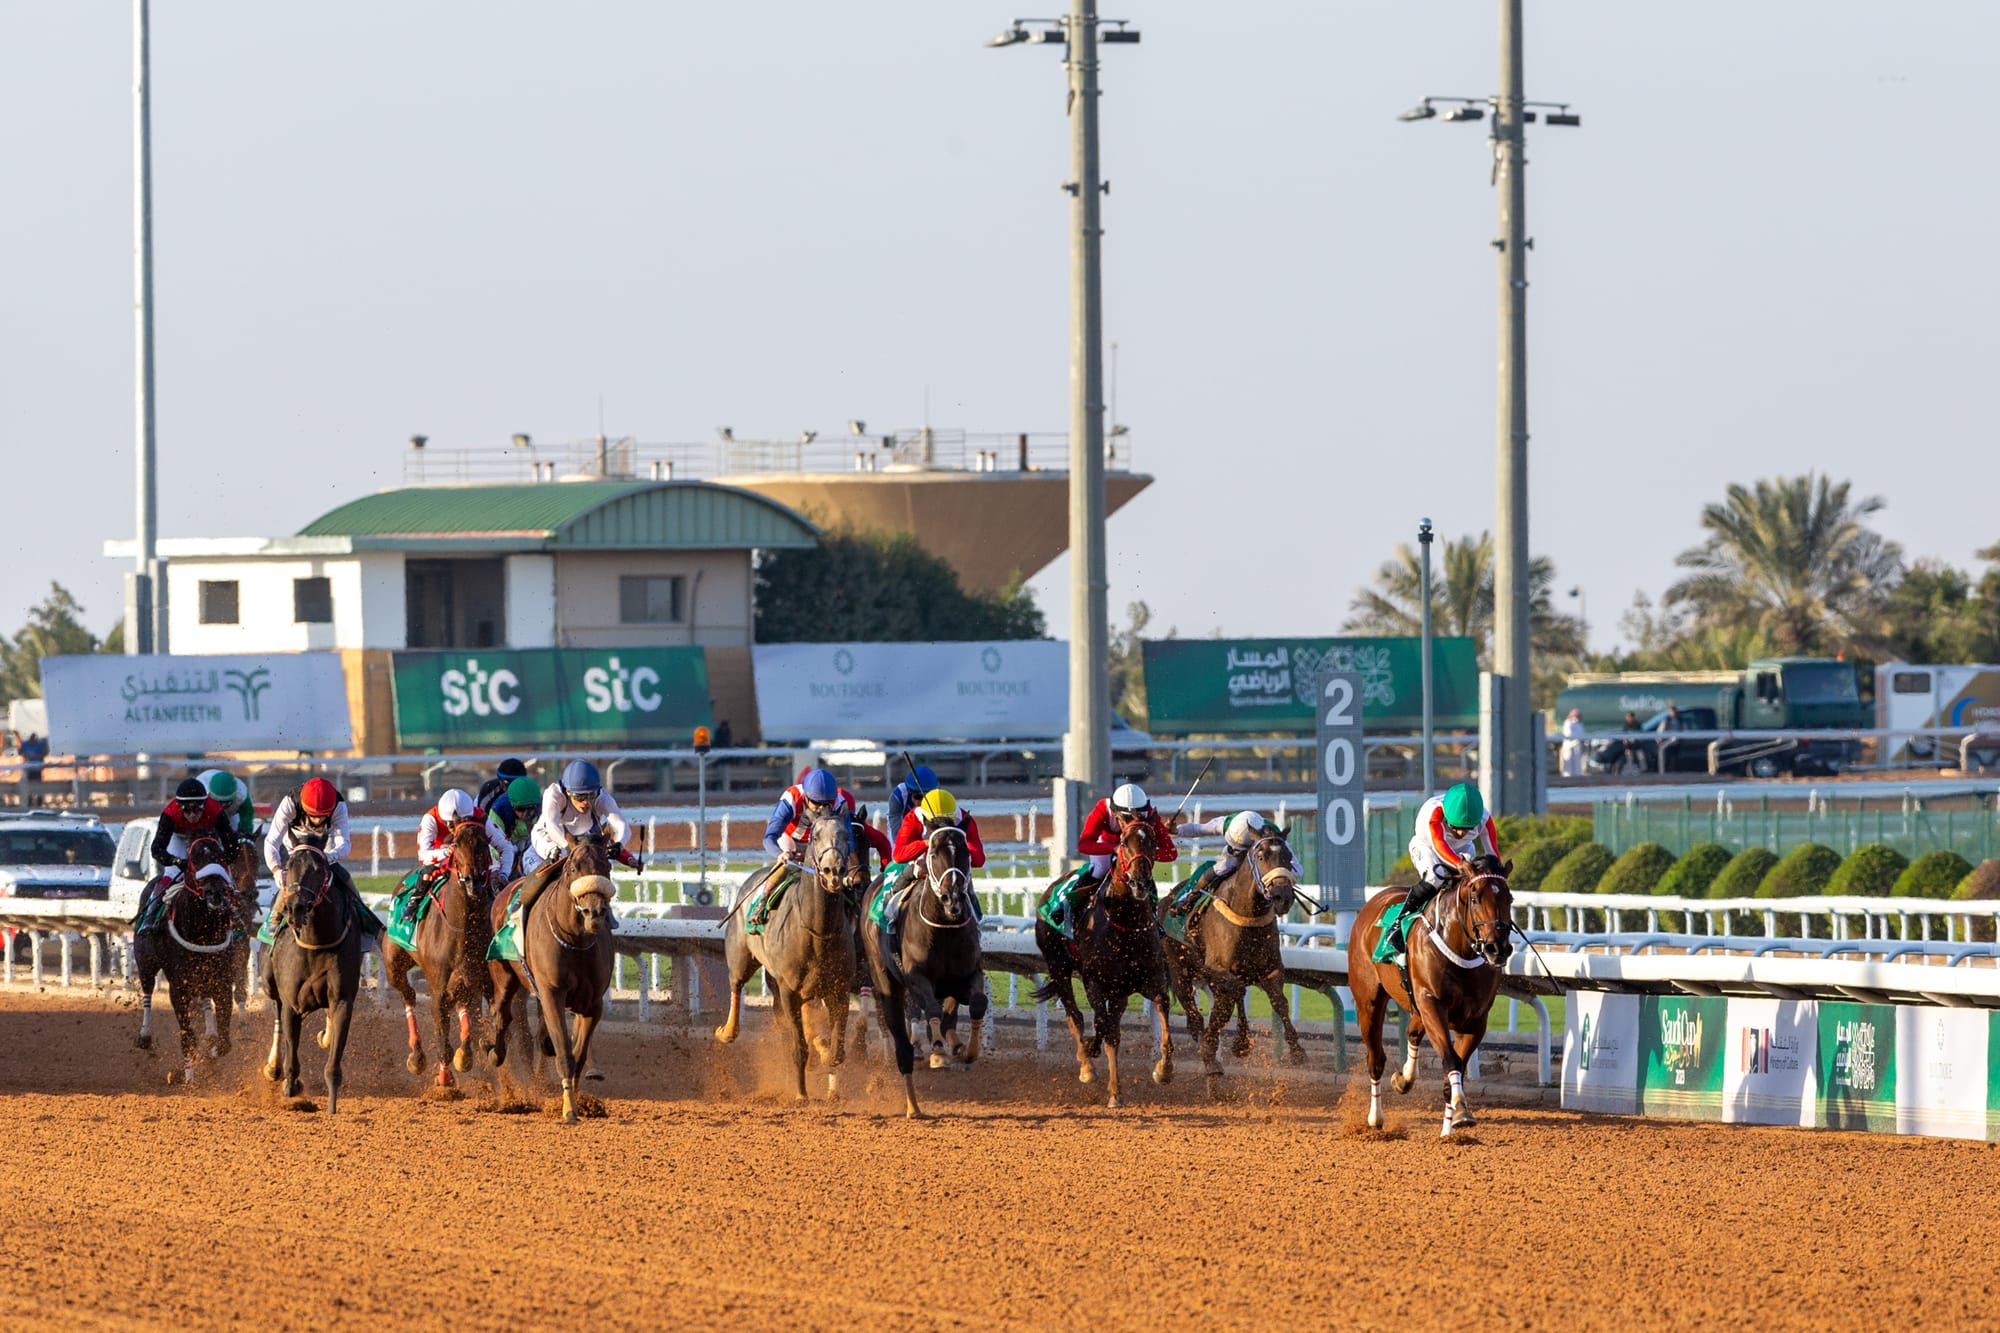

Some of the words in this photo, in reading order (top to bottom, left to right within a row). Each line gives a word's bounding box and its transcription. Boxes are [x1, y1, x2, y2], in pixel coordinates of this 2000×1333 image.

[1226, 646, 1289, 671] المسار
[120, 668, 220, 704] التنفيذي
[440, 658, 521, 717] stc
[584, 656, 663, 713] stc
[125, 704, 222, 722] ALTANFEETHI
[1325, 678, 1356, 846] 200
